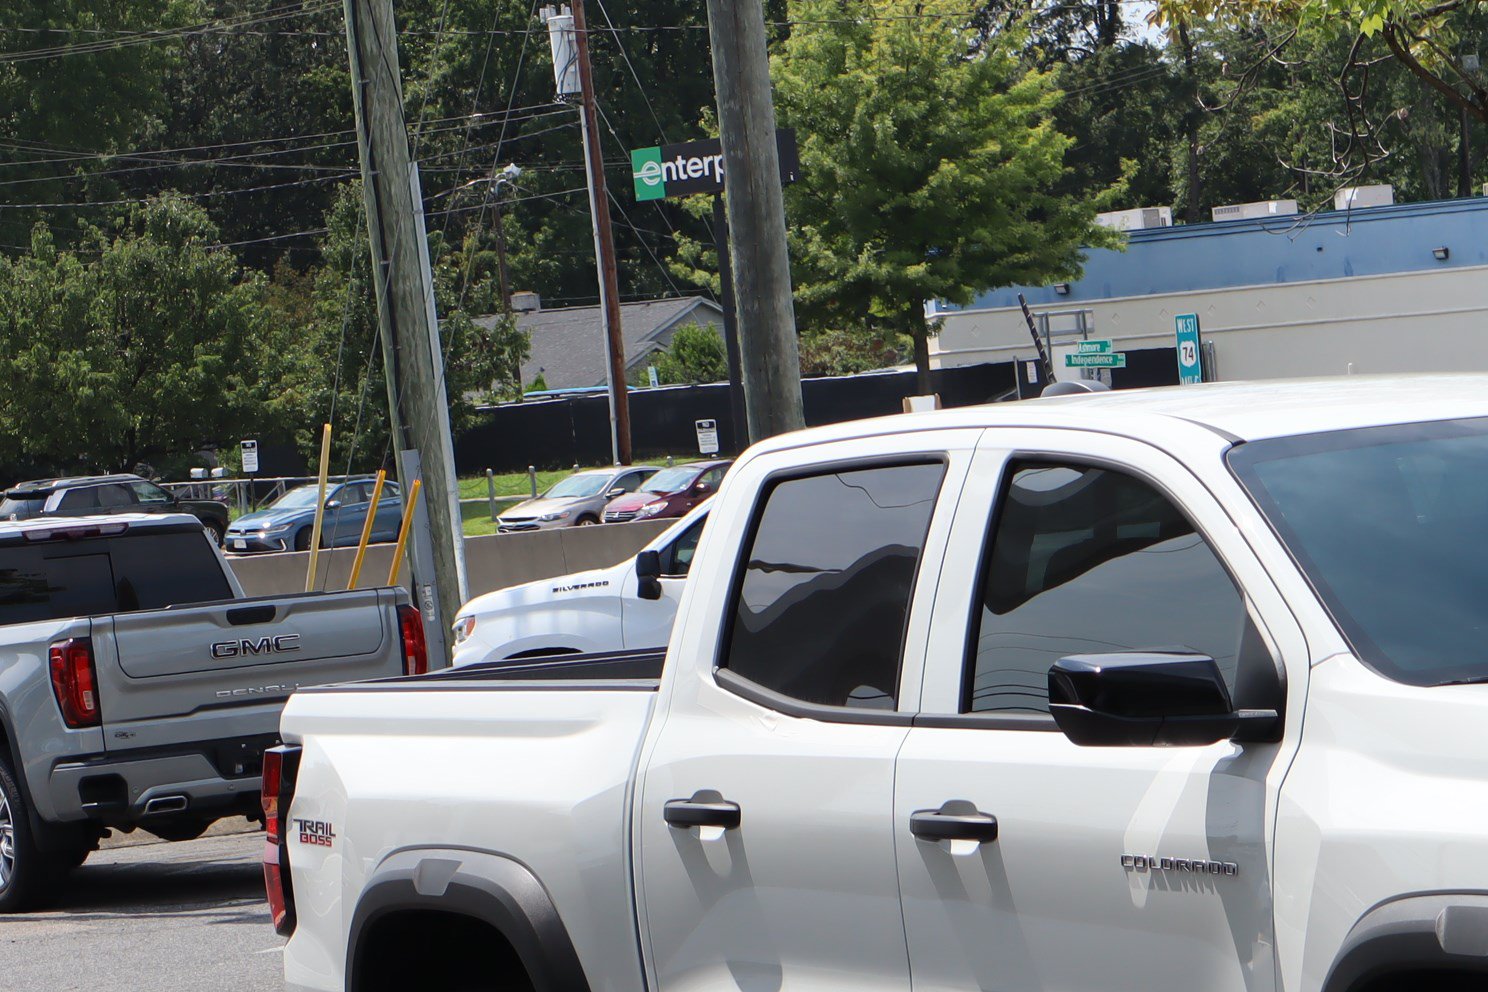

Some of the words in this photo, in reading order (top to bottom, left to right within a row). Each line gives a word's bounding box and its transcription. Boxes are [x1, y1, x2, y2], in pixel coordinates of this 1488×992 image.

[633, 153, 725, 187] enterp
[1176, 318, 1194, 333] WEST
[1182, 346, 1194, 361] 74
[552, 581, 610, 593] SILVERADO
[210, 633, 301, 660] GMC
[293, 819, 336, 837] TRAIL
[300, 833, 332, 848] BOSS
[1120, 853, 1239, 877] COLORADO
